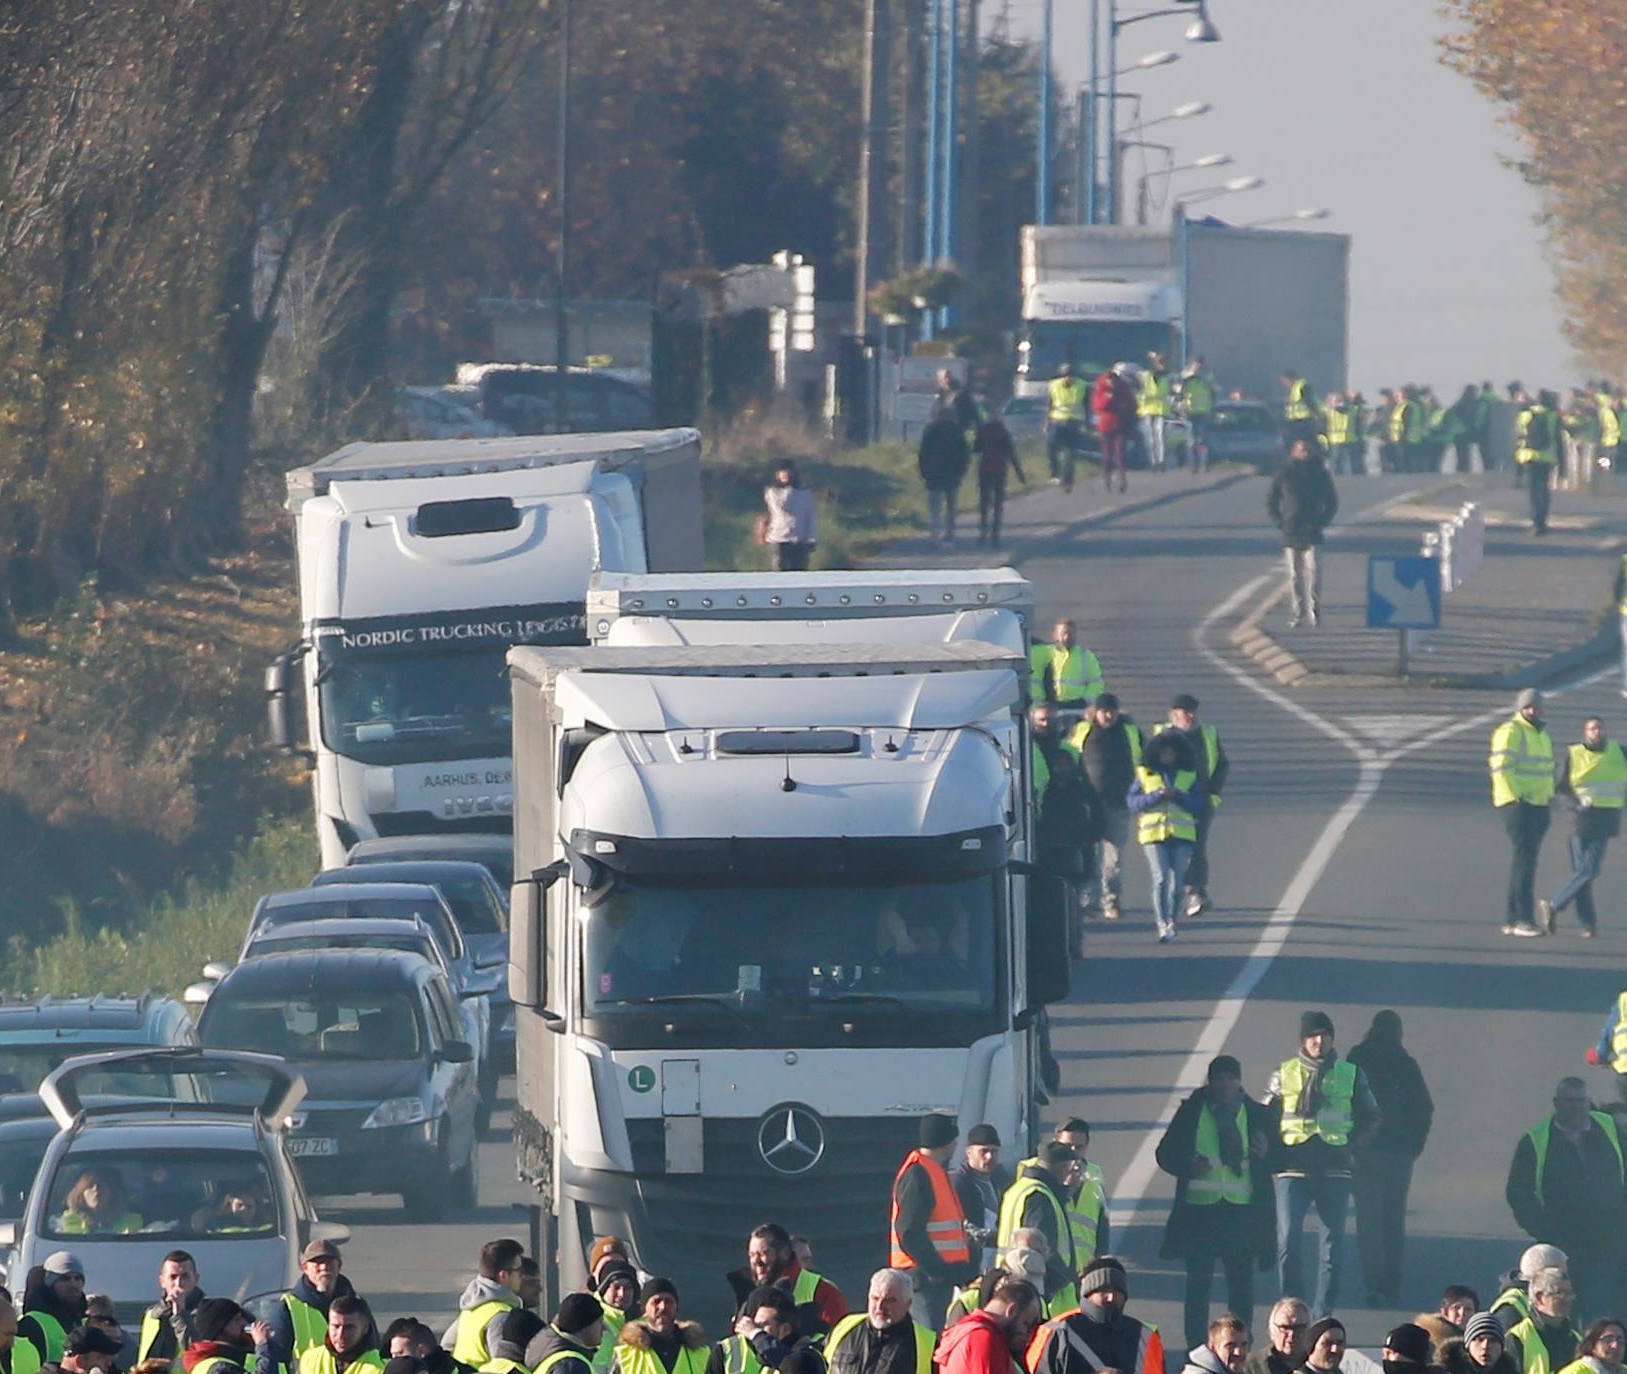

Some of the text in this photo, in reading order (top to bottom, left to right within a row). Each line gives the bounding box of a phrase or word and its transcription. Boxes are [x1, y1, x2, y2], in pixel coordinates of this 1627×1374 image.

[342, 628, 414, 649] NORDIC
[418, 619, 512, 643] TRUCKING
[635, 1070, 648, 1088] L
